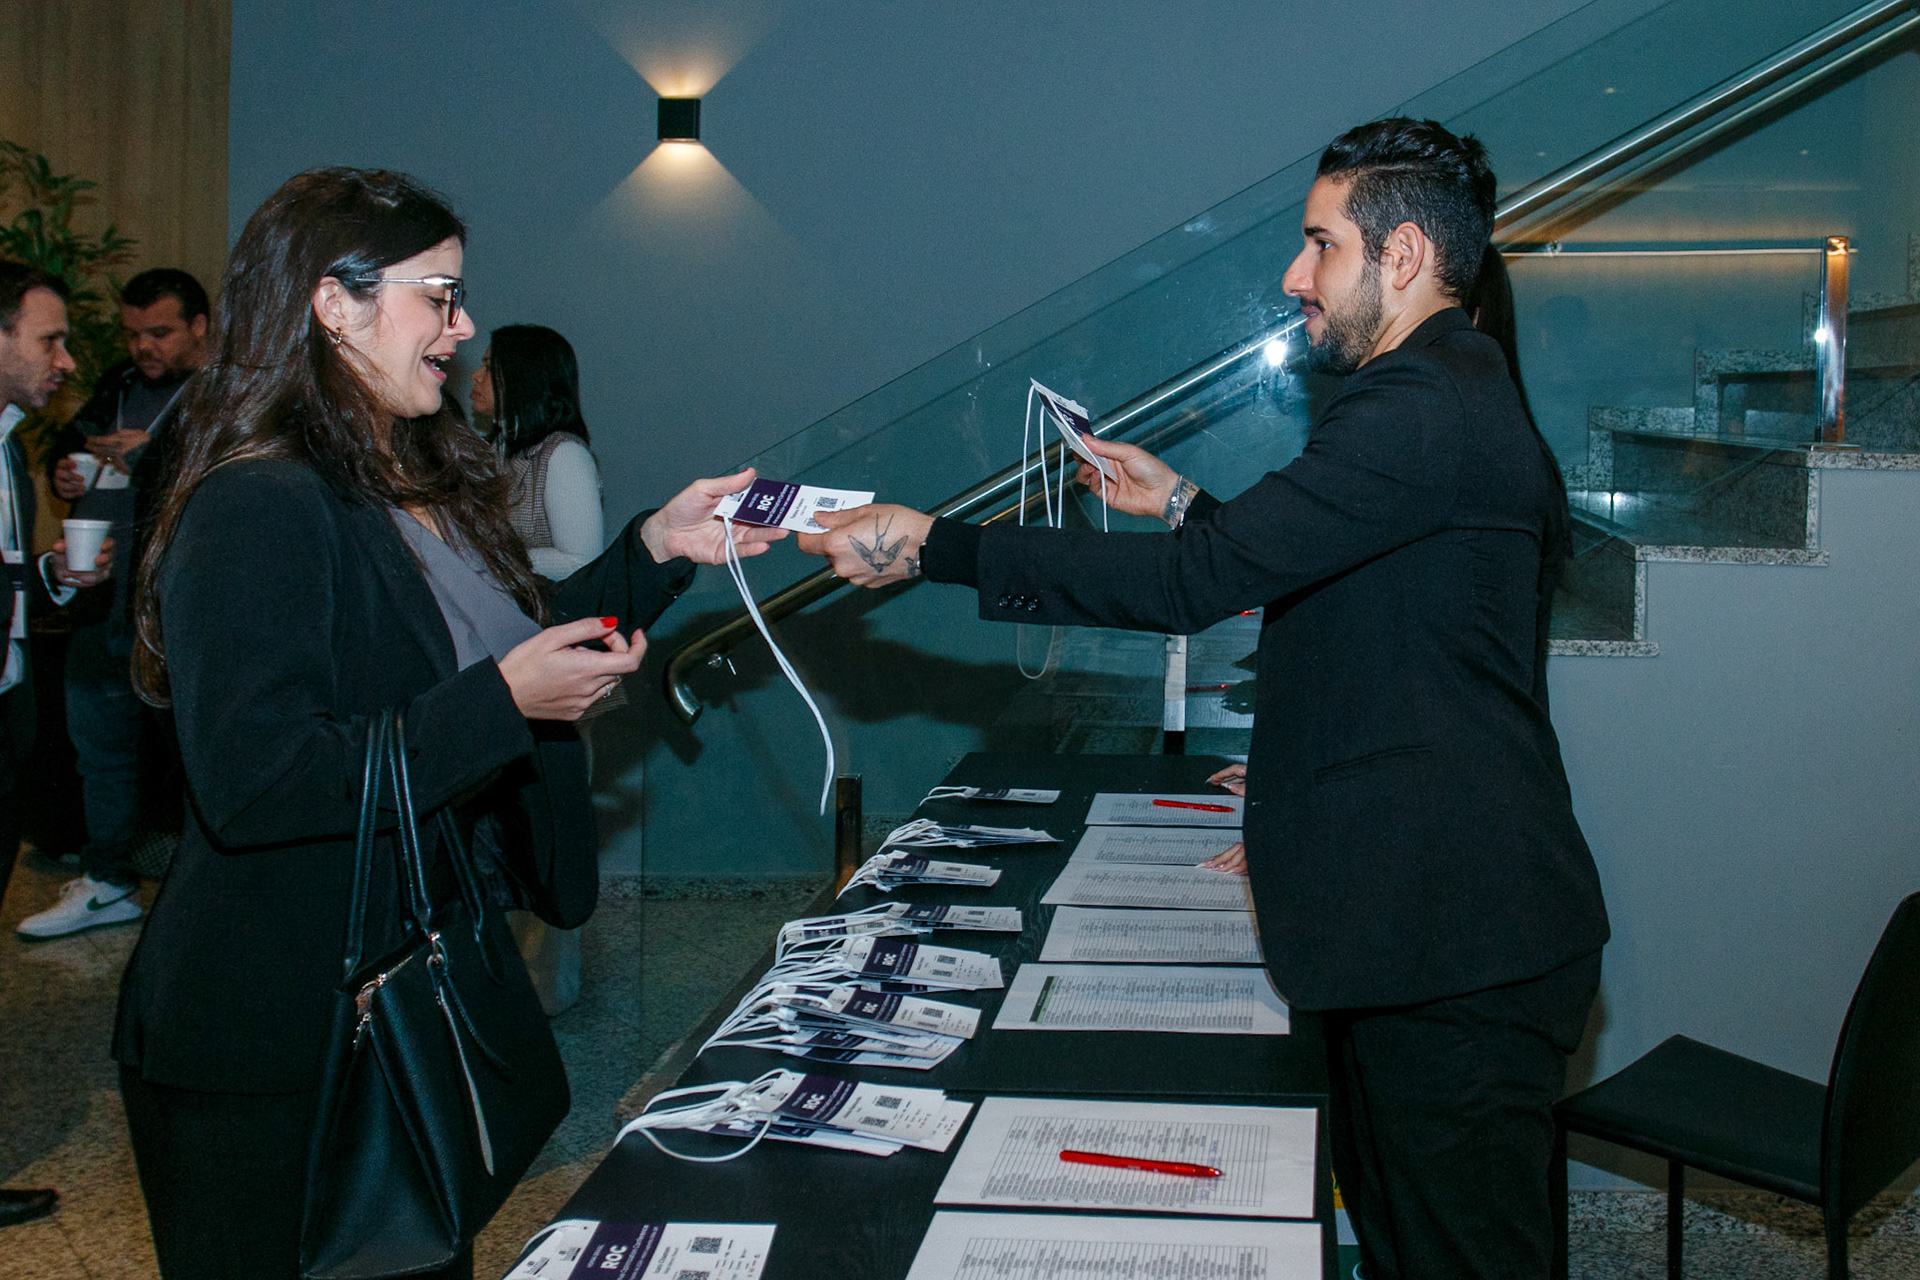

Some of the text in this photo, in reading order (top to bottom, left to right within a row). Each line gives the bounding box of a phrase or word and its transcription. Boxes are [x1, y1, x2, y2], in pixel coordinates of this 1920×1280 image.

[756, 494, 775, 511] ROC
[801, 1093, 826, 1110] ROC
[600, 1244, 628, 1269] ROC
